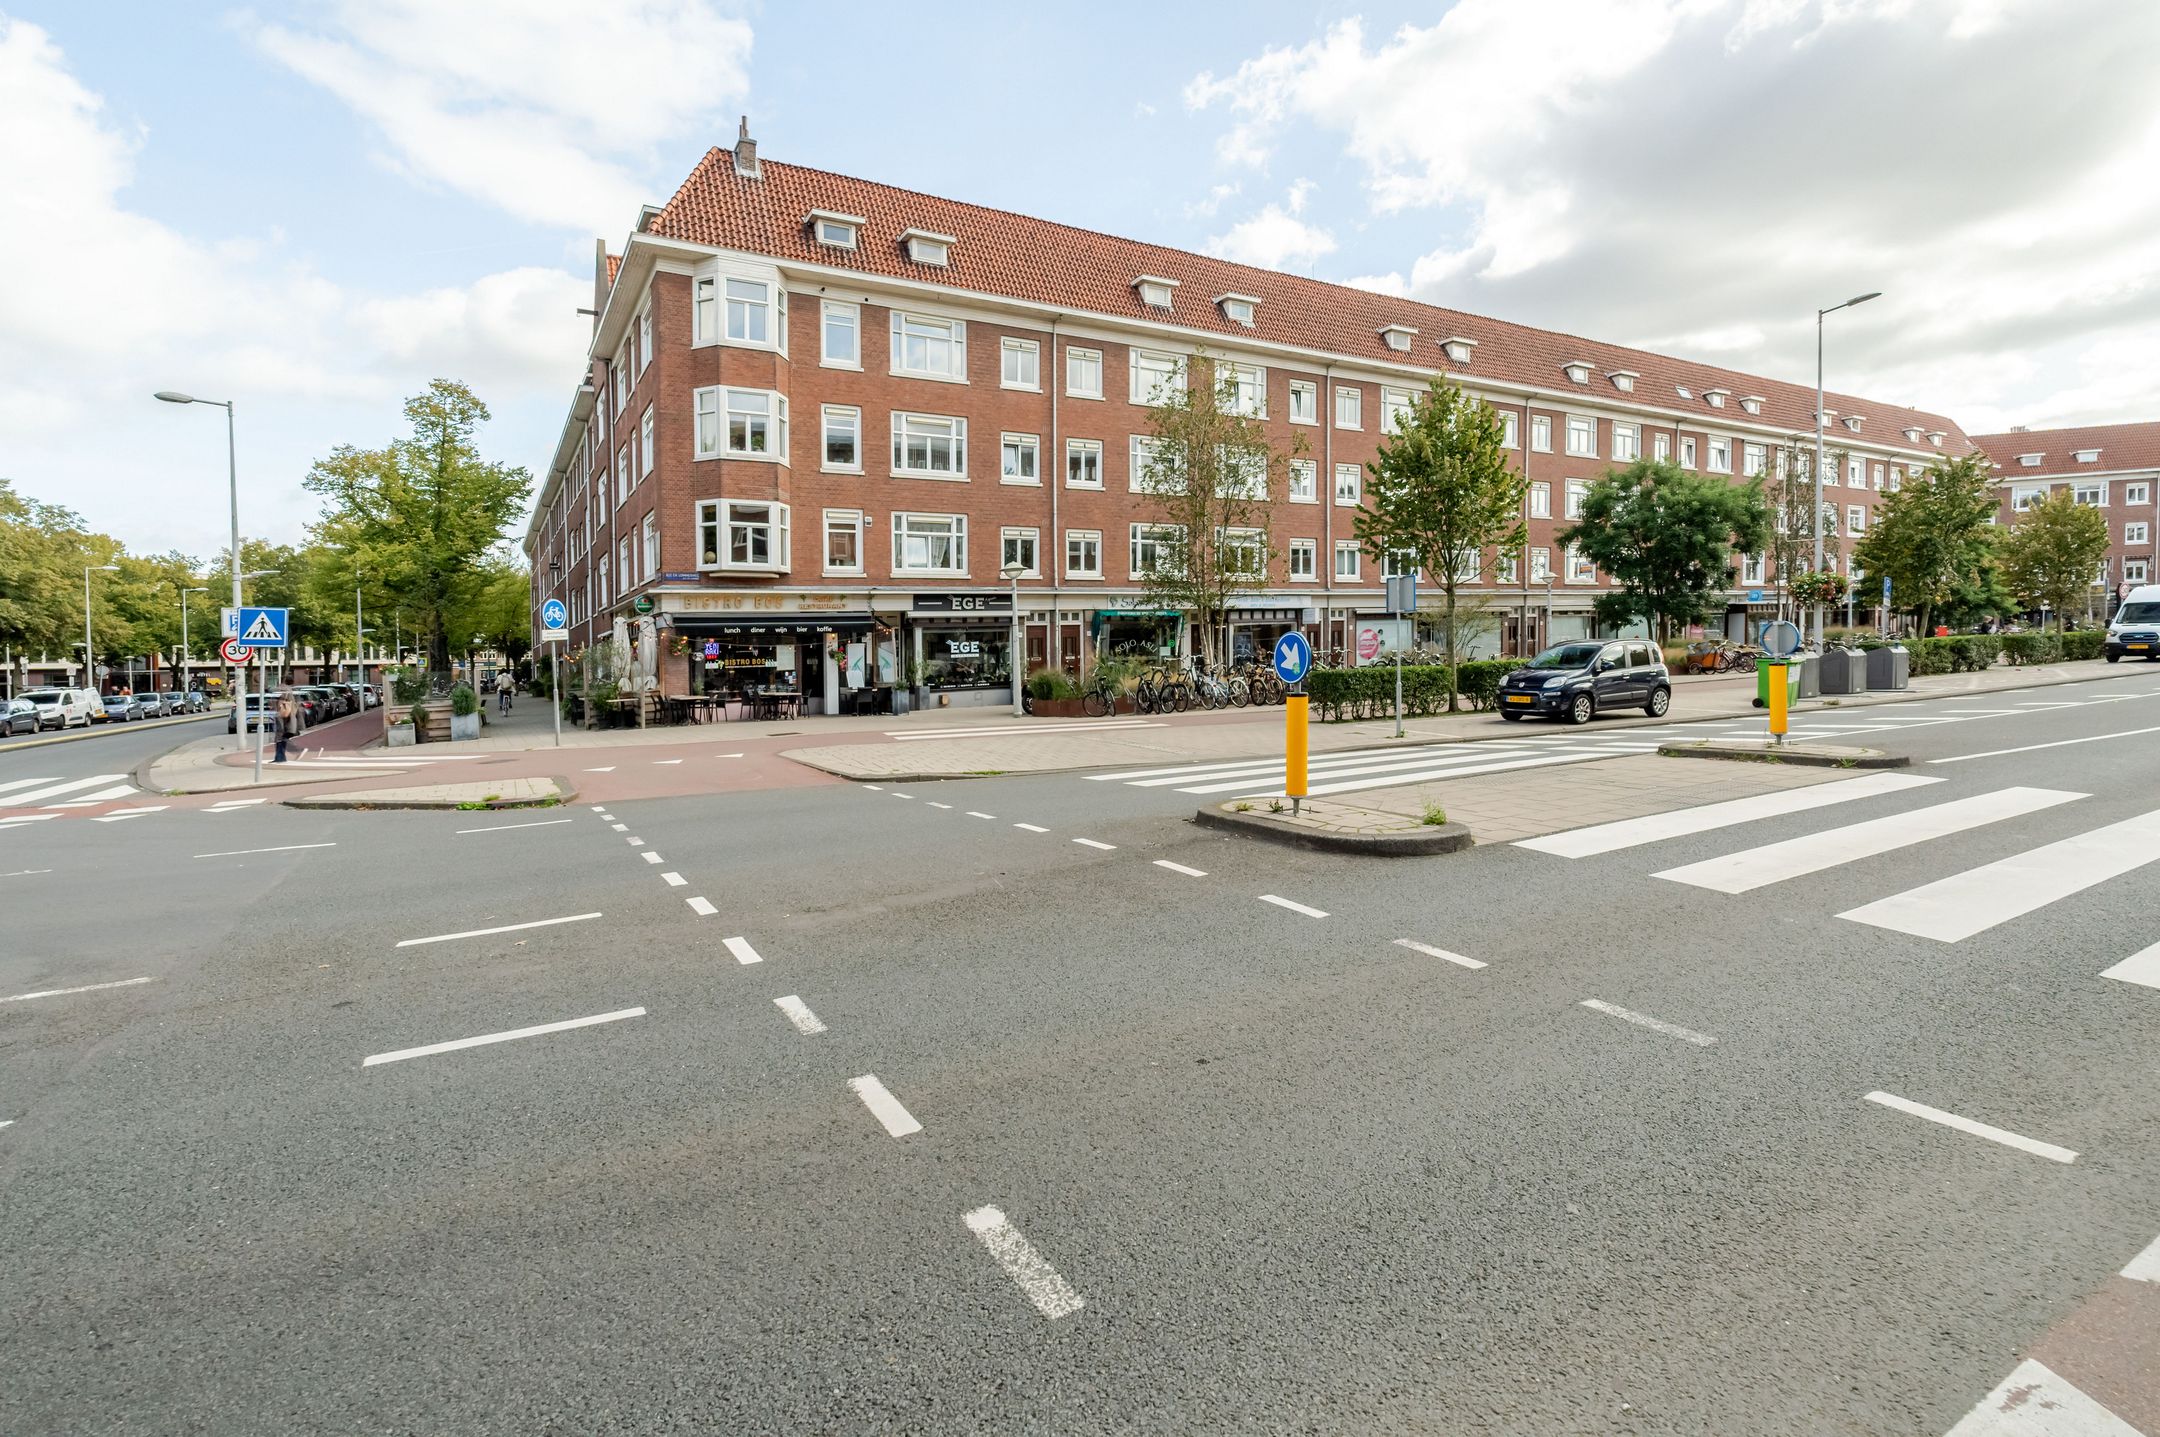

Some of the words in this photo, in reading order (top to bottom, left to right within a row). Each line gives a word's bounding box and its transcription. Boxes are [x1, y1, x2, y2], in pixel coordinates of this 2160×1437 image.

[684, 596, 742, 609] BISTRO
[754, 596, 783, 608] BOS
[951, 597, 985, 610] EGE
[228, 645, 248, 655] 30
[950, 641, 980, 653] EGE
[1140, 640, 1158, 653] ASLI
[752, 658, 766, 666] BOS
